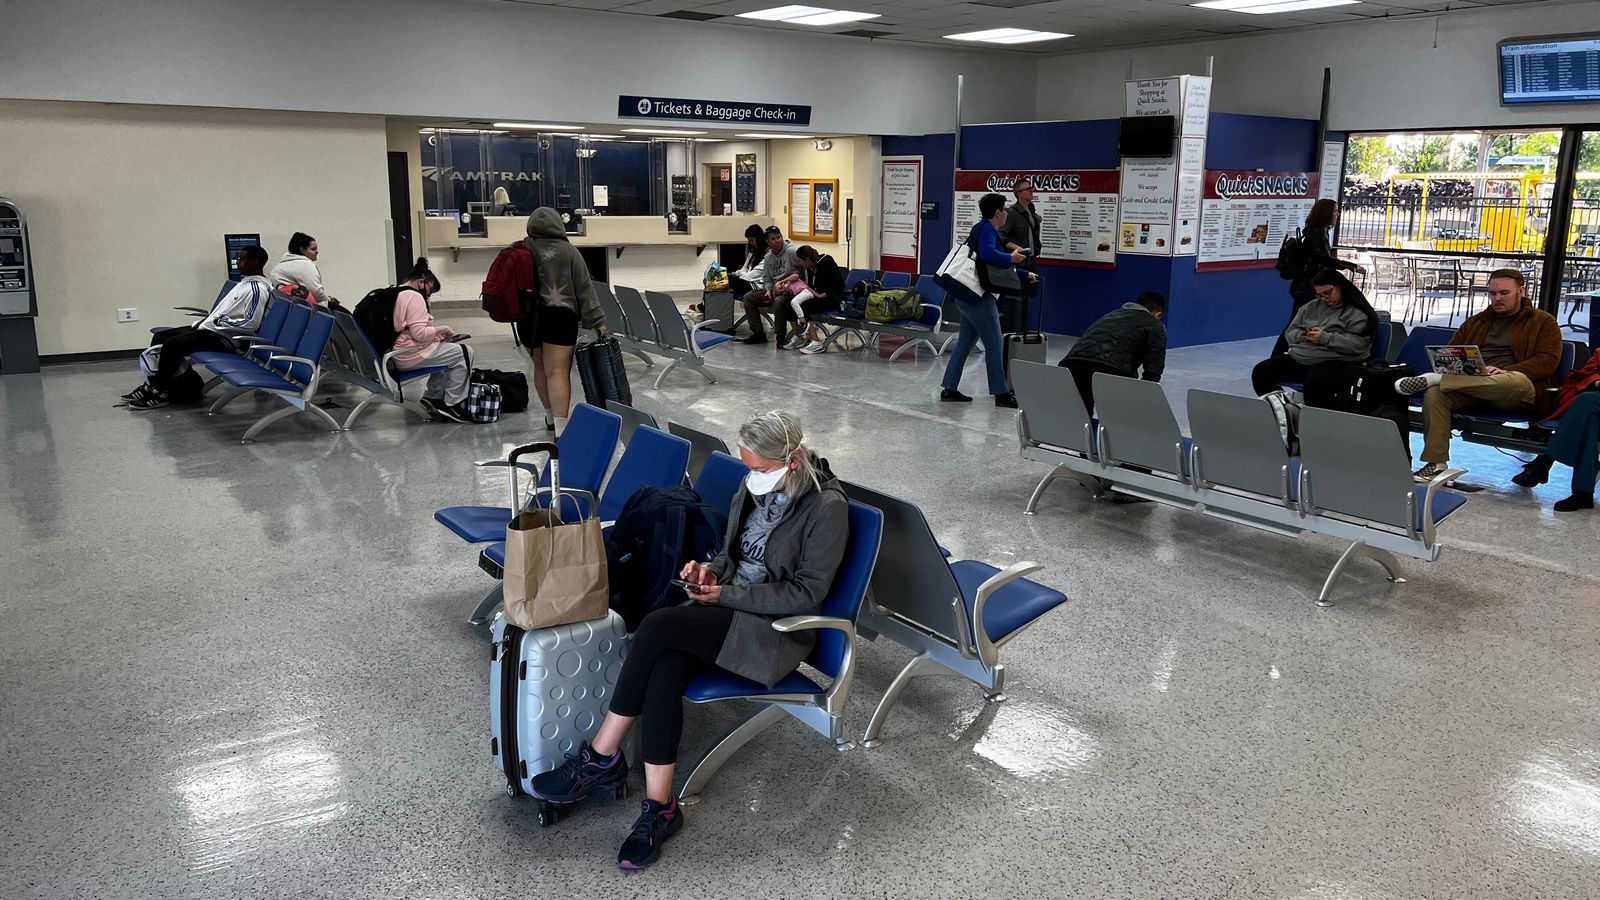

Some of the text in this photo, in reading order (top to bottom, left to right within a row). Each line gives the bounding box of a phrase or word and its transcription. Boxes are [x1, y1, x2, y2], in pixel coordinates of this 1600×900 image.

[654, 101, 796, 120] Tickets & Baggage Check-in
[449, 171, 543, 181] AMTRAK
